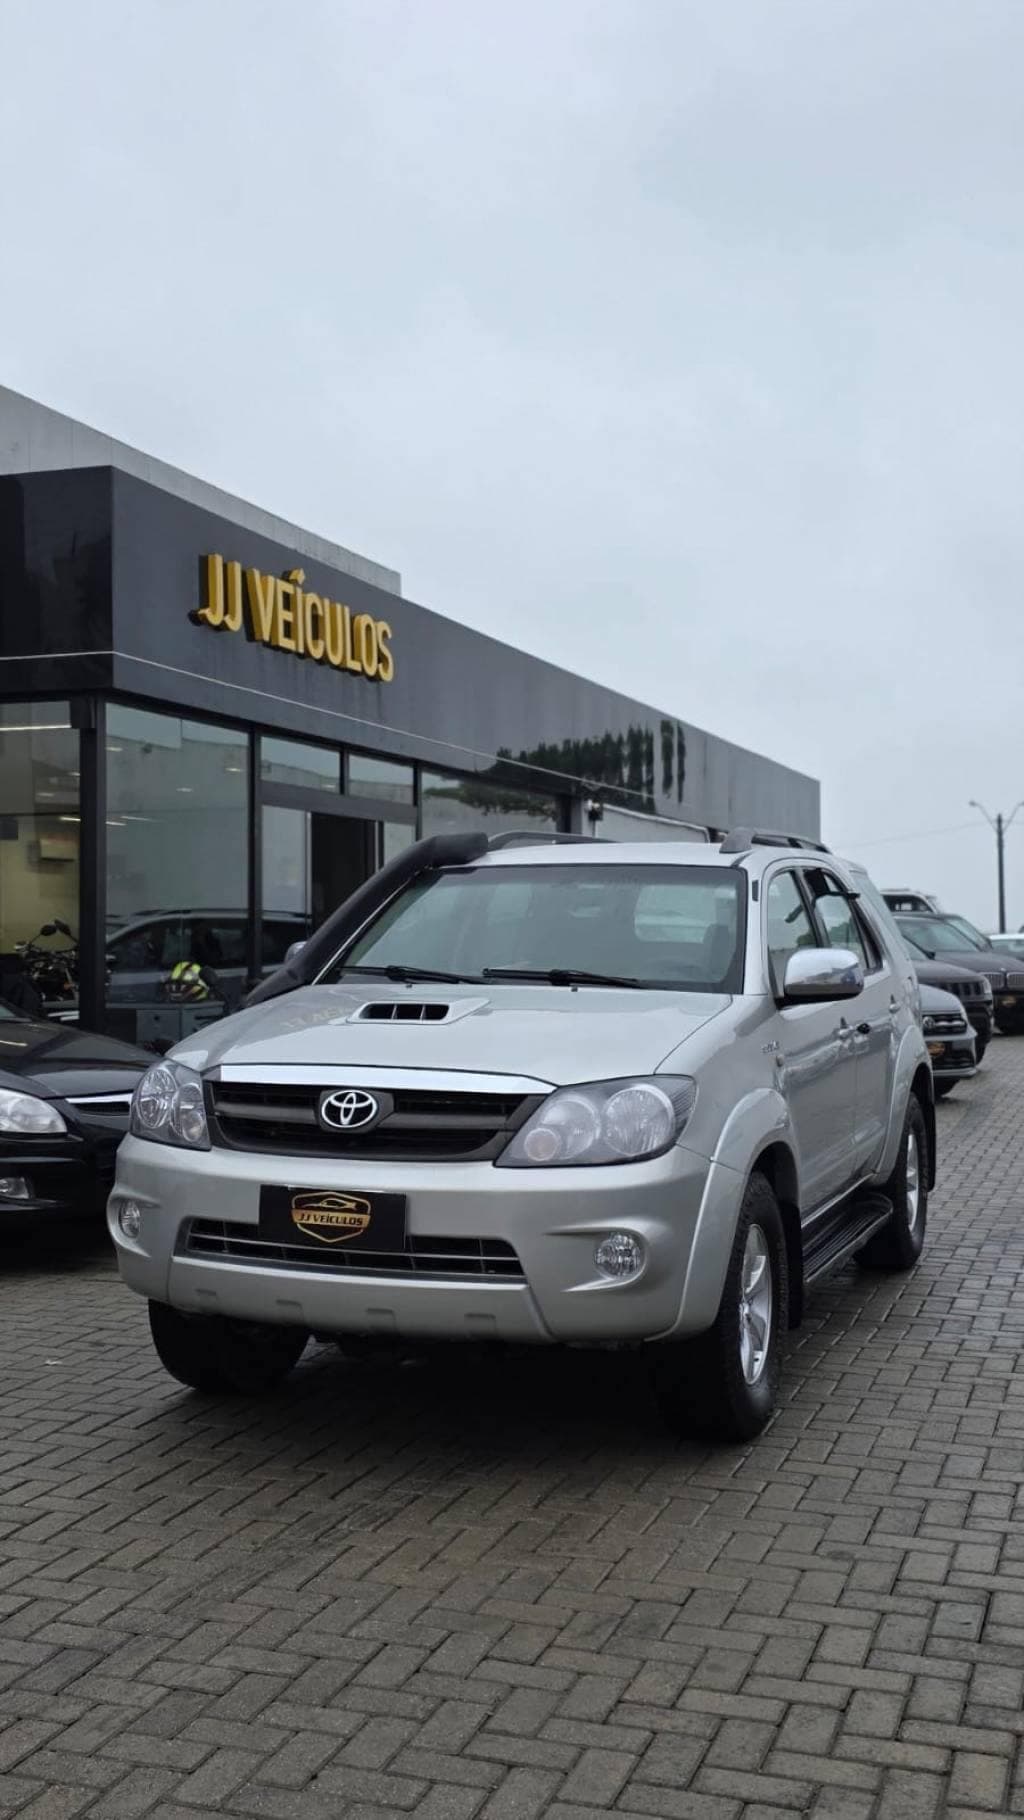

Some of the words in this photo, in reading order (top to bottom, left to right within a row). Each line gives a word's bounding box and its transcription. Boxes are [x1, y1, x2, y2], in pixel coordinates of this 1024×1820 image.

[197, 553, 242, 632] JJ
[246, 568, 394, 682] VEÍCULOS
[298, 1212, 310, 1222] JJ
